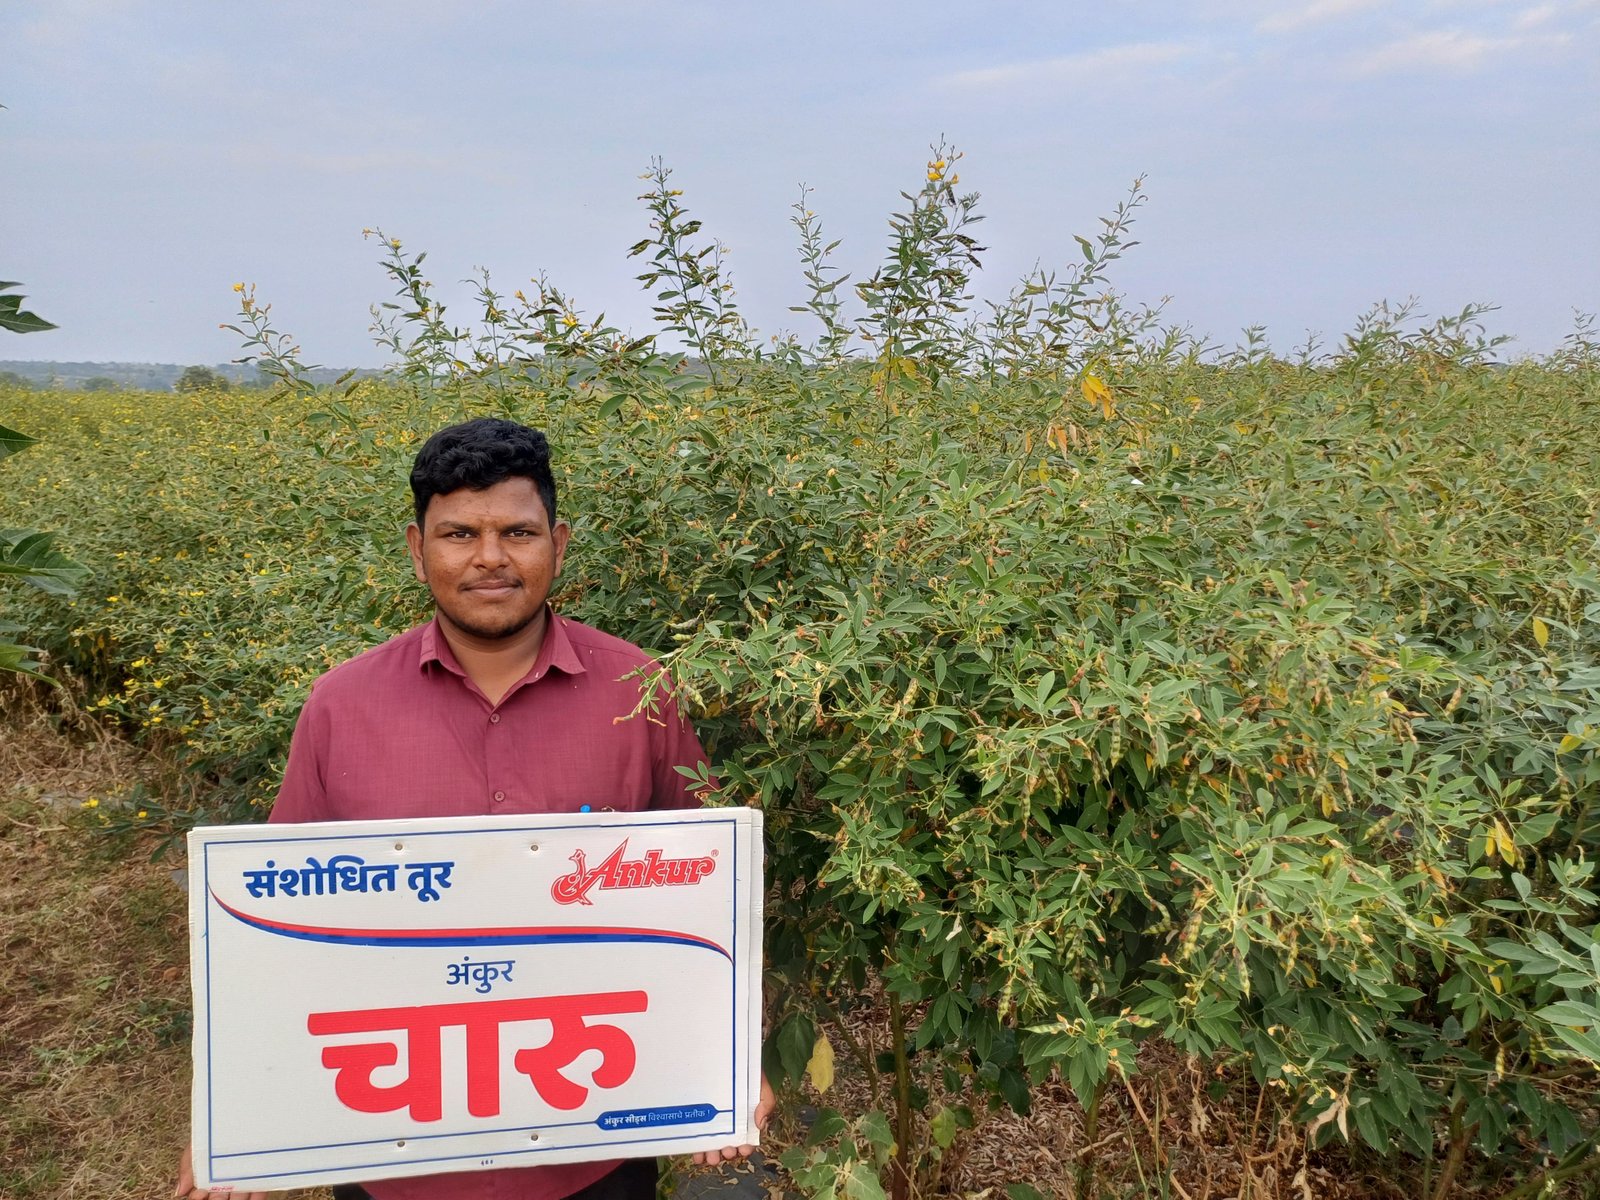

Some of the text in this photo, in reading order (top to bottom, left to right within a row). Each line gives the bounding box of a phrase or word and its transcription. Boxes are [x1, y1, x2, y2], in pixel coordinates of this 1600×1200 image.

[243, 854, 455, 903] संशोधित तूर
[588, 836, 716, 891] Ankur
[446, 955, 516, 994] अंकुर
[307, 989, 649, 1123] चारु
[604, 1115, 624, 1127] अंकुर
[624, 1113, 647, 1125] सीड्स
